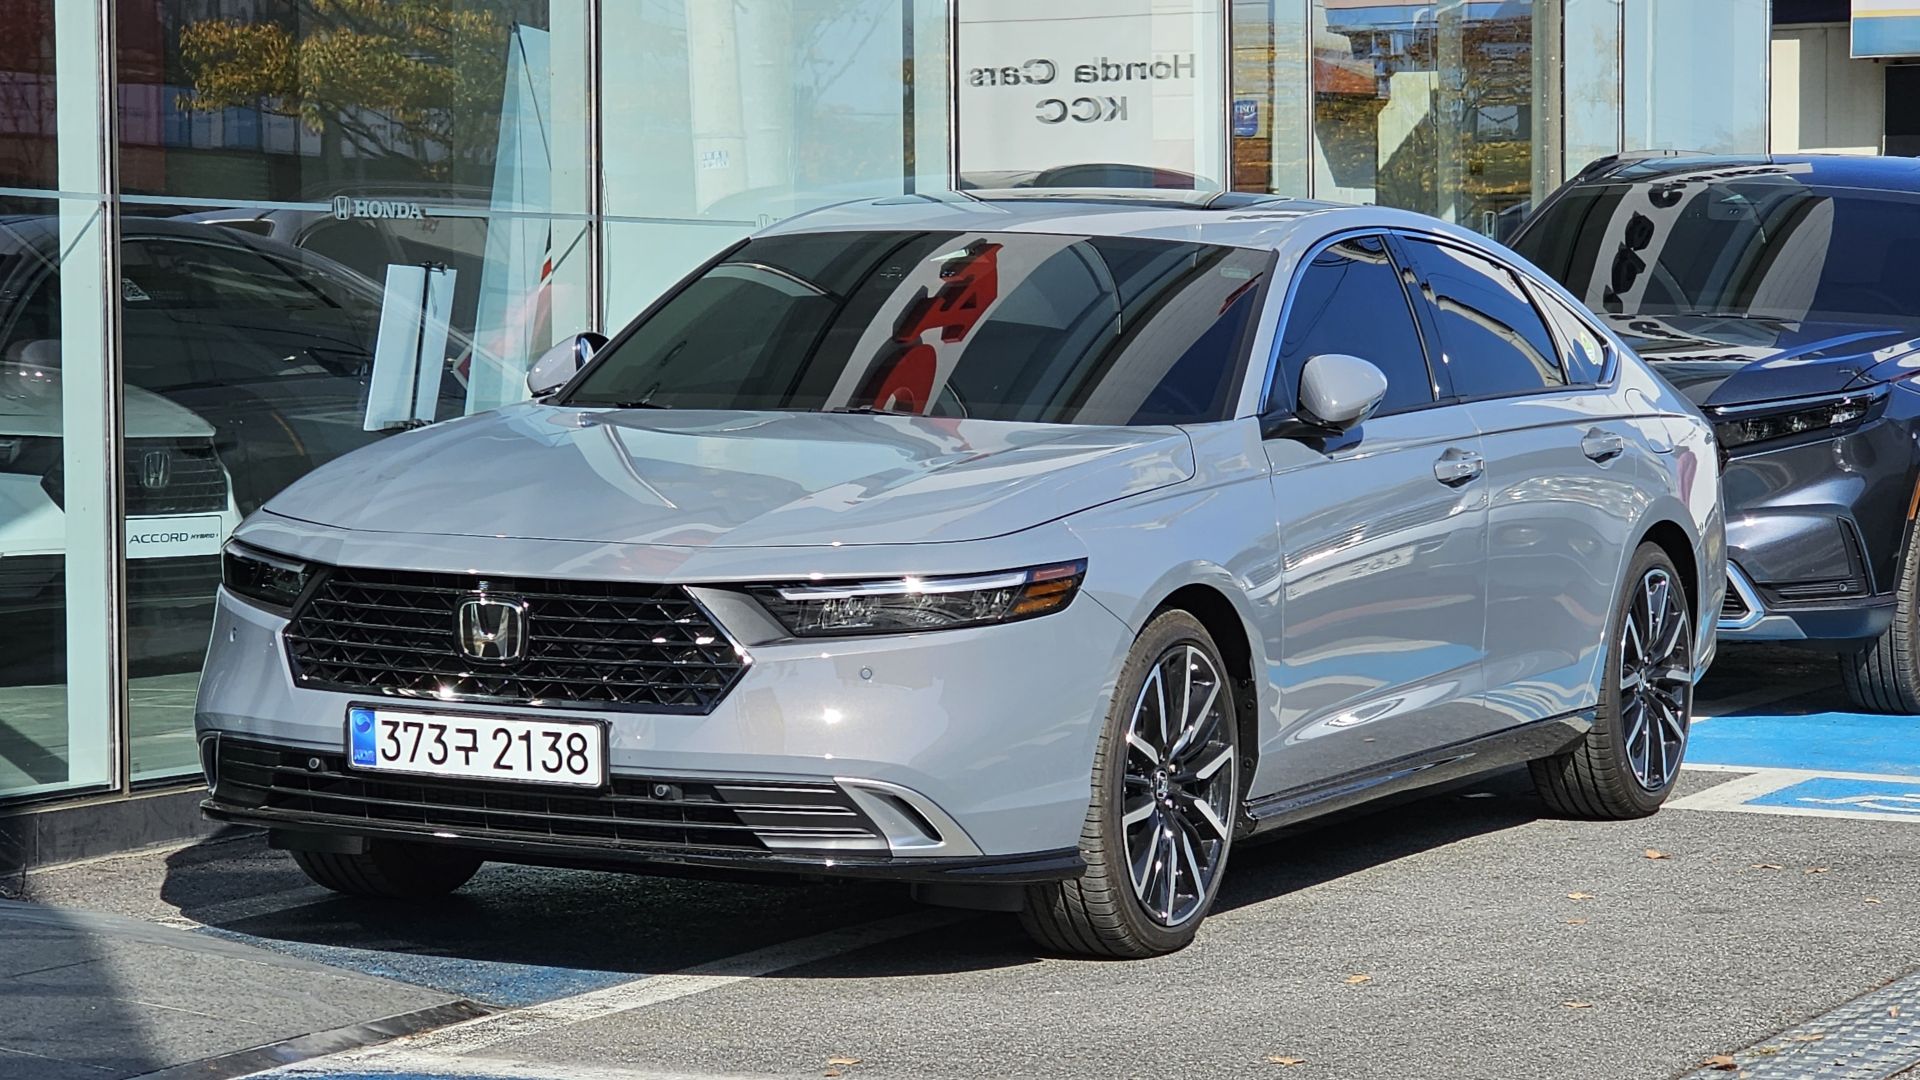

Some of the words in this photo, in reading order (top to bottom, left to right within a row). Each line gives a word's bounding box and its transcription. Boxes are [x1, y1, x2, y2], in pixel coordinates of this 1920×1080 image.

[353, 199, 424, 220] HONDA
[128, 532, 189, 544] ACCORD
[380, 719, 479, 767] 373구
[491, 727, 590, 776] 2138
